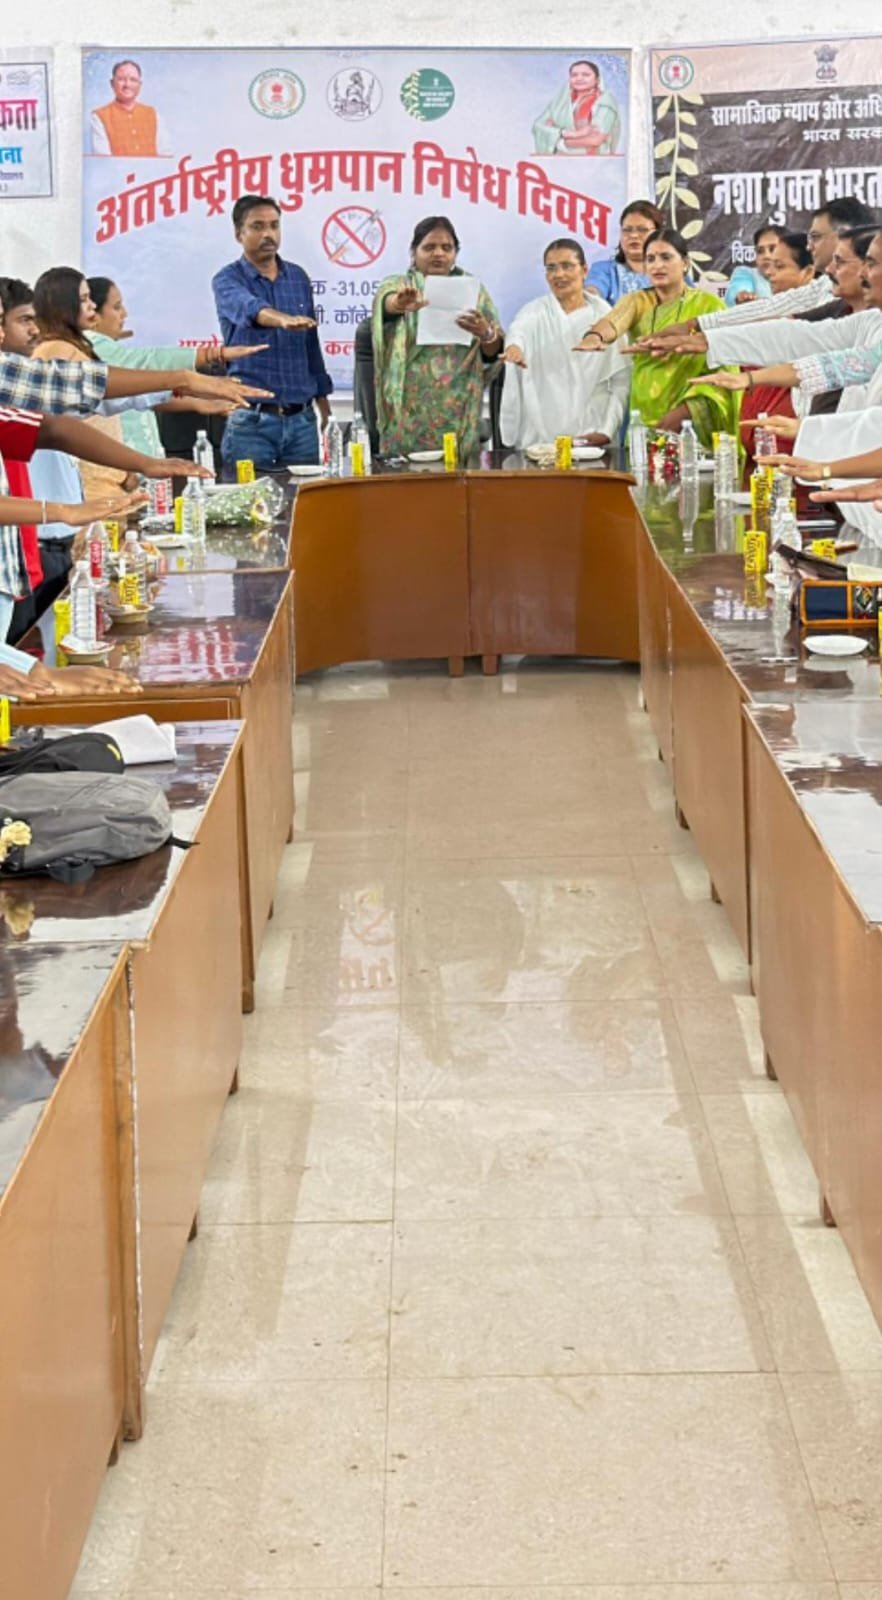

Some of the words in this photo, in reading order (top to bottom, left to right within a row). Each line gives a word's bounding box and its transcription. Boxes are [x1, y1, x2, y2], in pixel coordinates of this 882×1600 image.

[711, 100, 781, 126] सामाजिक
[784, 101, 821, 122] न्याय
[823, 94, 851, 120] और
[854, 94, 882, 119] अधि
[803, 128, 841, 142] भारत
[411, 141, 511, 210] निषेध
[516, 161, 612, 246] दिवस
[712, 172, 764, 214] नशा
[767, 169, 822, 226] मुक्त
[732, 240, 756, 264] विक
